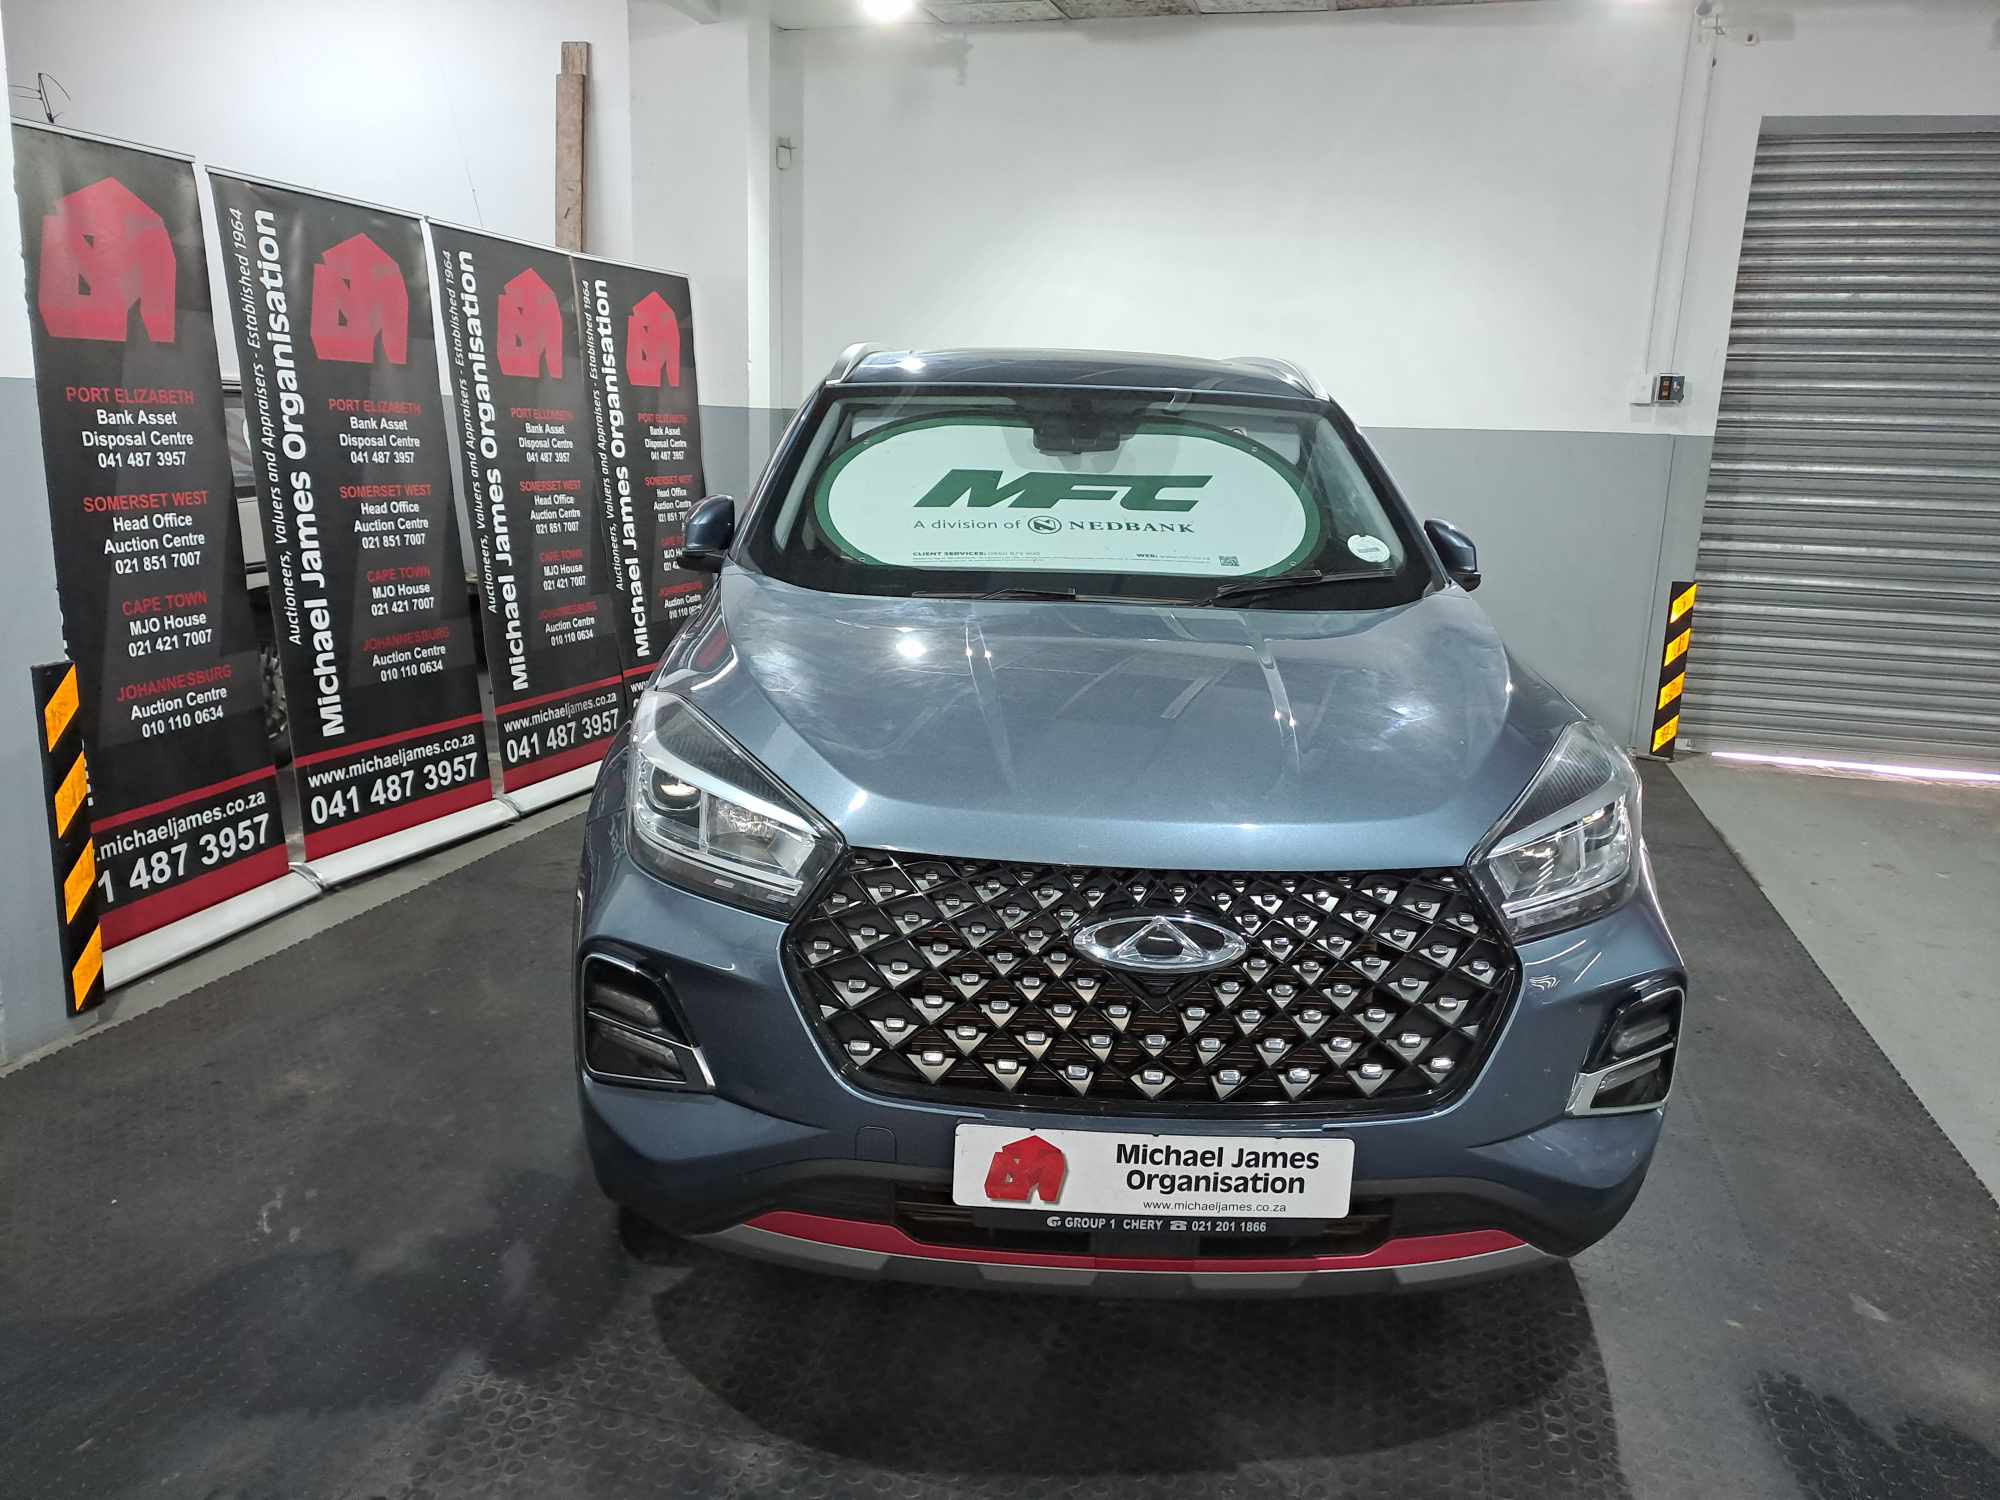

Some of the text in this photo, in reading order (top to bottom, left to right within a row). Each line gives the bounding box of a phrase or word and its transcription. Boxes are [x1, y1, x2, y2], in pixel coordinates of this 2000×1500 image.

[229, 207, 247, 250] 1964
[442, 250, 455, 285] 1964
[234, 253, 260, 349] Established
[447, 288, 465, 367] Established
[595, 279, 625, 458] Organisation
[66, 386, 194, 405] PORT ELIZABETH
[253, 363, 276, 448] Appraisers
[328, 399, 360, 412] PORT
[97, 409, 178, 425] Bank Asset
[350, 416, 408, 430] Bank Asset
[456, 379, 475, 450] Appraisers
[81, 430, 194, 449] Disposal Centre
[339, 434, 420, 449] Disposal Centre
[98, 451, 186, 468] 041 487 3957
[262, 451, 280, 483] and
[351, 451, 414, 463] 041 487 3957
[466, 452, 478, 478] and
[255, 210, 345, 737] Michael James Organisation
[459, 251, 528, 691] Michael James Organisation
[83, 490, 209, 513] SOMERSET WEST
[339, 485, 401, 498] SOMERSET
[913, 469, 1213, 512] MFC
[271, 485, 288, 544] Valuers
[360, 501, 420, 515] Head Office
[475, 483, 487, 530] Valuers
[530, 509, 557, 521] Auction
[616, 466, 637, 550] James
[113, 513, 193, 532] Head Office
[354, 517, 429, 533] Auction Centre
[913, 519, 1195, 533] A division of NEDBANK
[104, 532, 205, 555] Auction Centre
[362, 533, 426, 549] 021 851 7007
[115, 551, 201, 575] 021 851 7007
[479, 534, 498, 613] Auctioneers,
[560, 563, 583, 575] House
[280, 551, 302, 645] Auctioneers,
[372, 582, 431, 599] MJO House
[543, 580, 555, 591] 021
[122, 591, 208, 616] CAPE TOWN
[371, 597, 434, 616] 021 421 7007
[625, 557, 650, 657] Michael
[129, 611, 207, 637] MJO House
[545, 620, 571, 633] Auction
[128, 629, 212, 658] 021 421 7007
[372, 644, 446, 667] Auction Centre
[116, 664, 232, 702] JOHANNESBURG
[380, 660, 443, 683] 010 110 0634
[130, 687, 227, 721] Auction Centre
[504, 692, 617, 733] www.michaeljames.co.za
[141, 705, 224, 738] 010 110 0634
[507, 708, 619, 763] 041 487 3957
[308, 733, 475, 789] www.michaeljames.co.za
[311, 752, 478, 825] 041 487 3957
[96, 791, 266, 862] .michaeljames.co.za
[129, 842, 188, 891] 487
[199, 813, 270, 866] 3957
[1116, 1143, 1320, 1170] Michael James
[1126, 1169, 1305, 1195] Organisation
[1143, 1200, 1287, 1213] www.michaeljames.co.za
[1064, 1216, 1267, 1233] GROUP 1 CHERY 021 201 1866
